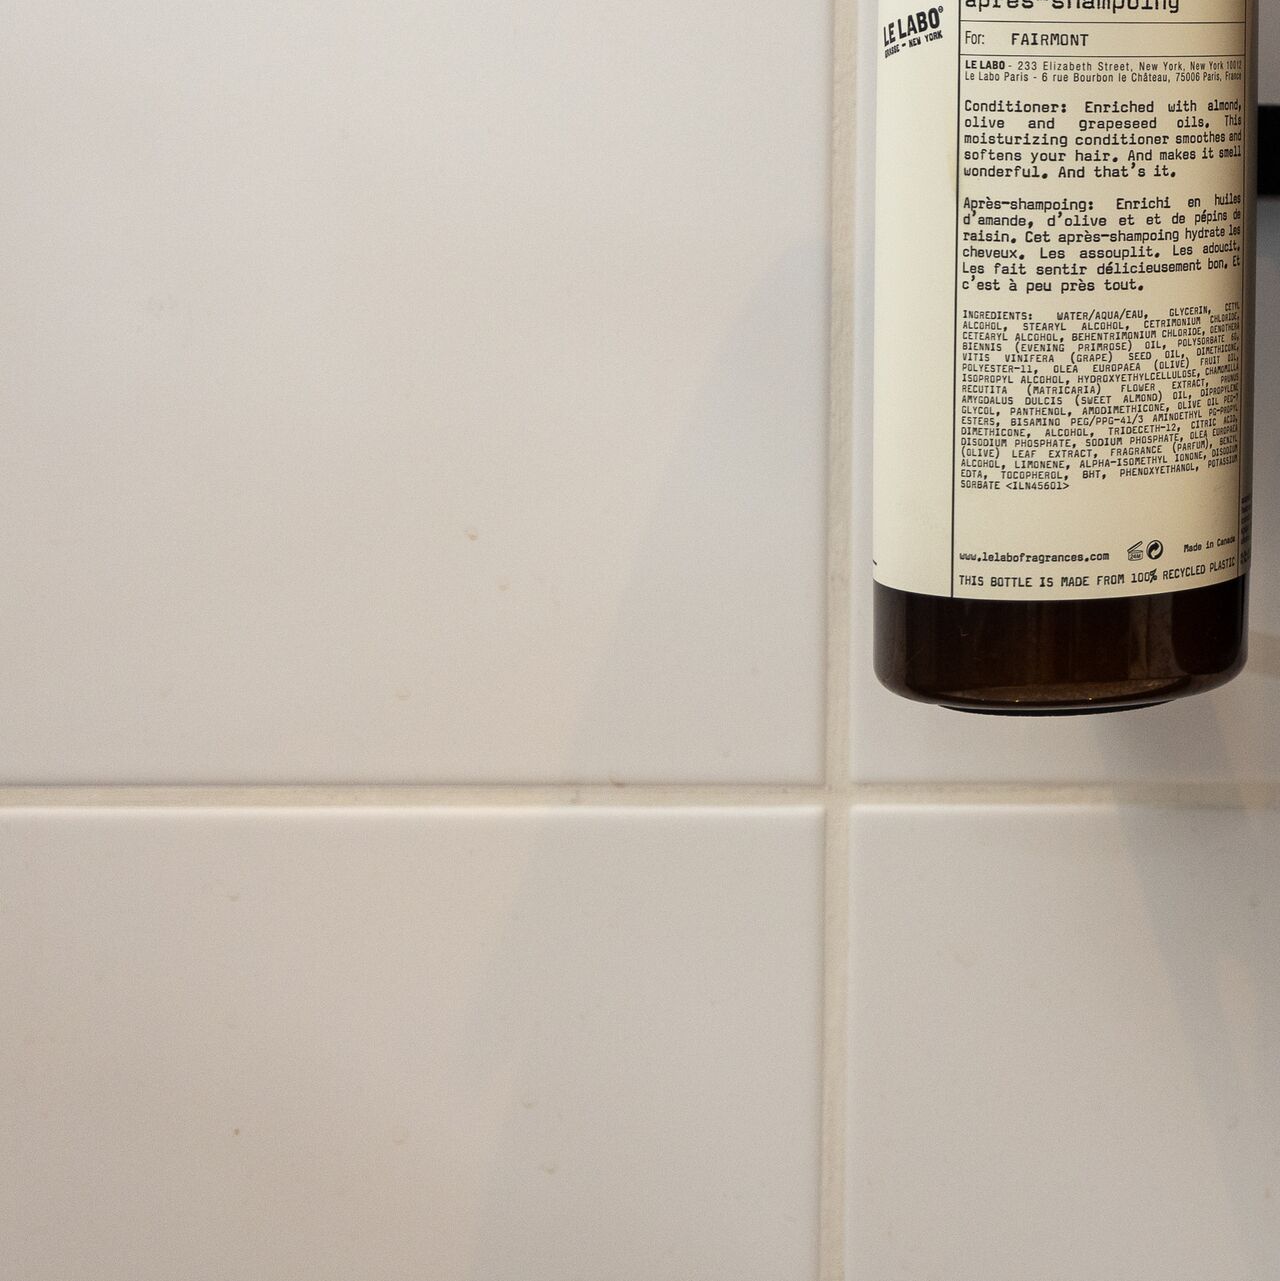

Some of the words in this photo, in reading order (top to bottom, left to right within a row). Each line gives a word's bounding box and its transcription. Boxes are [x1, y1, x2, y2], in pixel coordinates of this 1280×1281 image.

[883, 22, 896, 47] LE
[908, 36, 921, 48] NEW
[924, 30, 943, 42] YORK
[965, 30, 984, 45] For:
[1011, 33, 1089, 46] FAIRMONT
[965, 99, 1066, 113] Conditioner:
[1085, 100, 1154, 113] Enriched
[1168, 100, 1197, 112] with
[1208, 99, 1241, 112] almond,
[965, 116, 1005, 128] olive
[1028, 117, 1055, 129] and
[1079, 117, 1157, 132] grapeseed
[1177, 116, 1209, 131] oils.
[1225, 114, 1241, 126] This
[964, 132, 1068, 147] moisturizing
[1075, 133, 1169, 145] conditioner
[1175, 131, 1225, 144] smoothes
[1229, 130, 1241, 141] and
[964, 149, 1022, 161] softens
[1030, 152, 1066, 164] your
[1075, 149, 1118, 163] hair.
[1128, 149, 1152, 161] And
[1160, 148, 1196, 160] makes
[1202, 147, 1214, 159] it
[1219, 145, 1241, 158] smell
[961, 480, 1000, 490] SORBATE
[1006, 481, 1069, 490] <ILN45601>
[1184, 543, 1202, 553] Made
[1206, 541, 1214, 549] in
[959, 552, 1109, 564] www.lelabofragrances.com
[959, 575, 984, 586] THIS
[990, 577, 1033, 587] BOTTLE
[1039, 577, 1053, 587] IS
[1061, 576, 1090, 587] MADE
[1097, 574, 1125, 586] FROM
[1131, 568, 1158, 583] 100%
[1163, 564, 1206, 580] RECYCLED
[1210, 557, 1235, 572] PLASTIC
